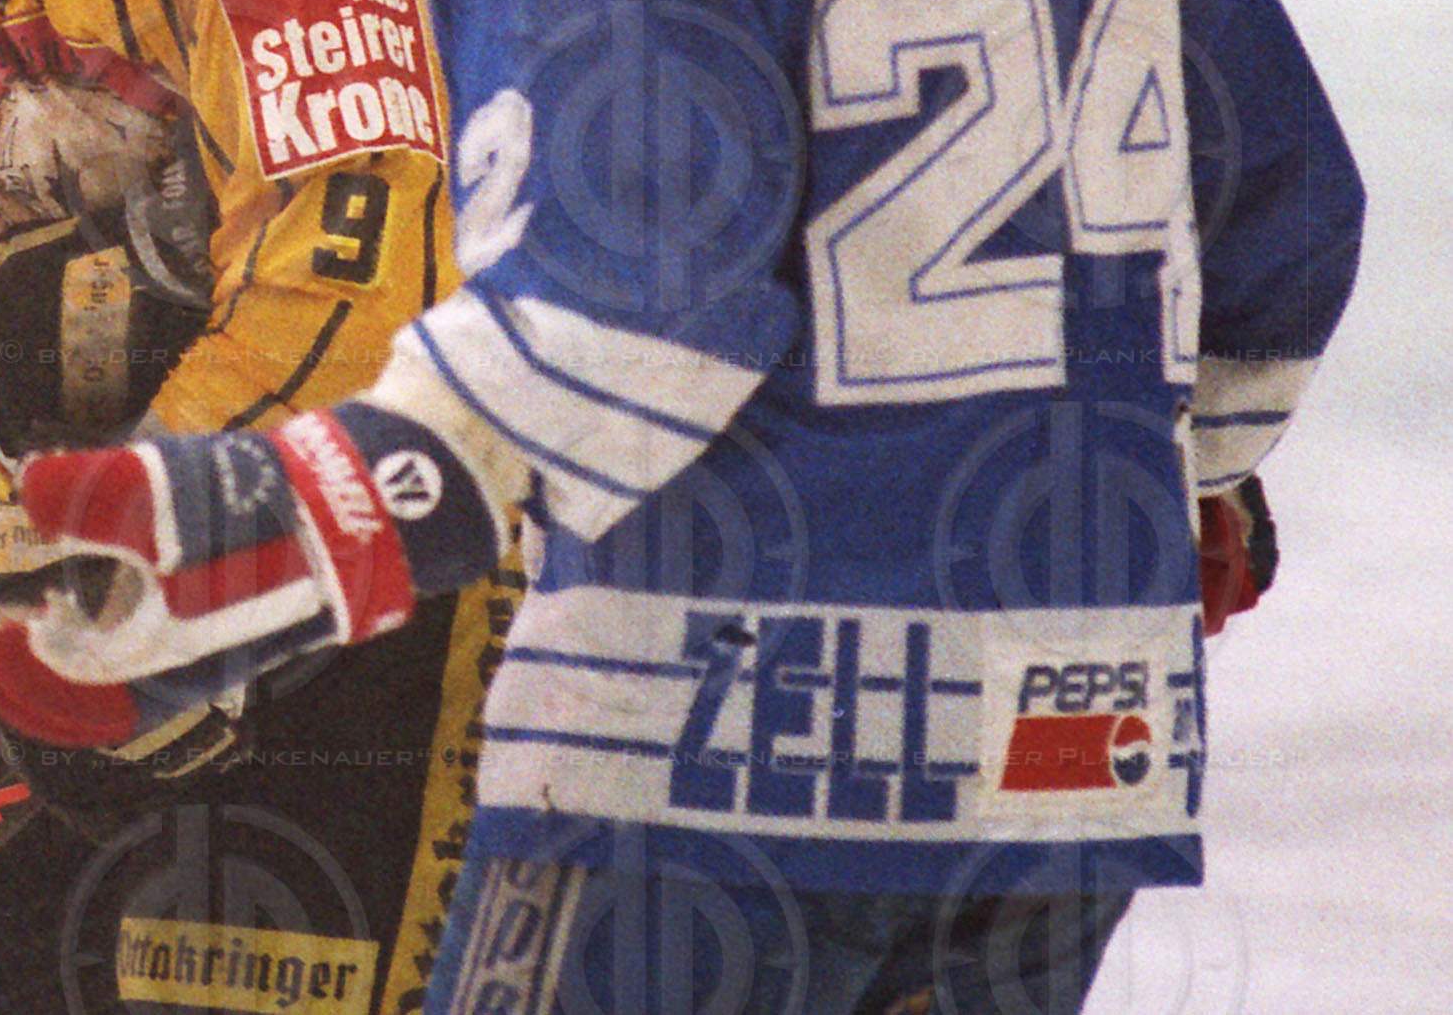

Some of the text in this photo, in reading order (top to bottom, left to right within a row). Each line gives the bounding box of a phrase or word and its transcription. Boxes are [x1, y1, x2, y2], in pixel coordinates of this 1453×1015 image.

[251, 6, 416, 91] steirer
[260, 76, 434, 164] Krone
[311, 171, 391, 283] 9
[668, 610, 959, 821] ZELL
